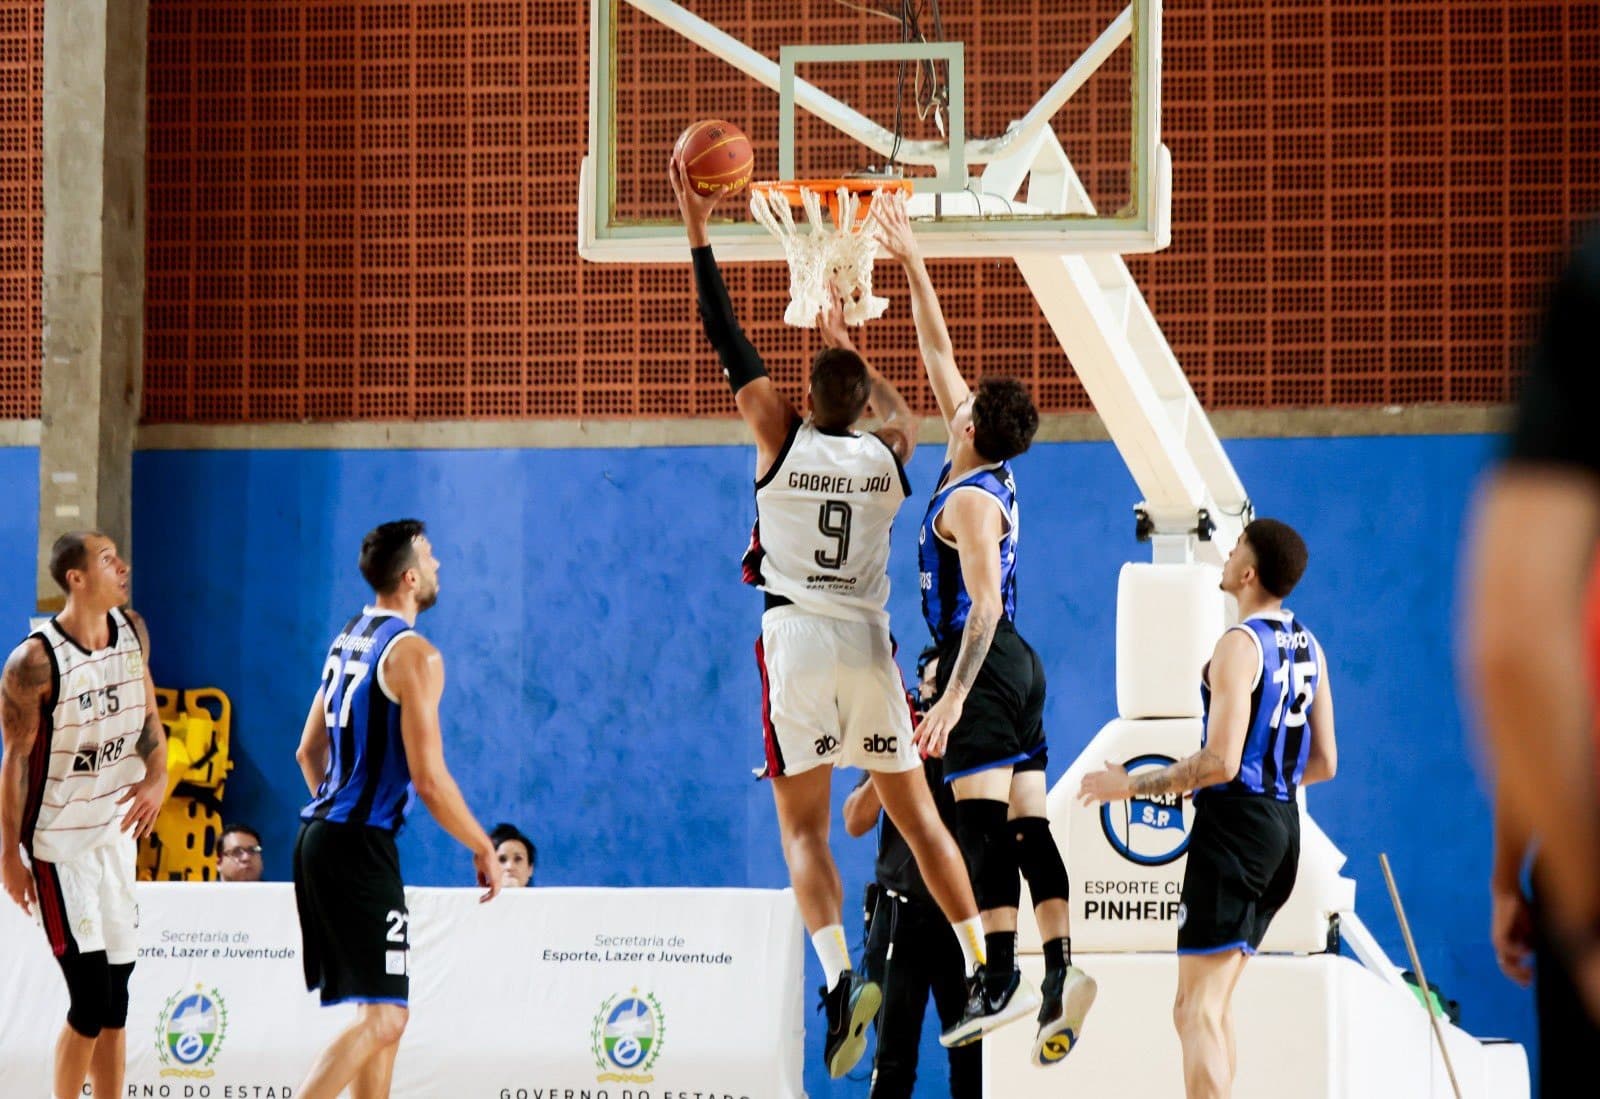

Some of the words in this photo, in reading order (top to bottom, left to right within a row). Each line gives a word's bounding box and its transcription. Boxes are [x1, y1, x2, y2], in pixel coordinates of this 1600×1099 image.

[789, 472, 854, 494] GABRIEL
[860, 472, 891, 493] JAÚ
[815, 500, 852, 569] 9
[322, 655, 370, 728] 27
[1269, 659, 1317, 728] 15
[814, 733, 840, 756] ab
[863, 734, 897, 753] abc
[97, 737, 125, 771] RB
[1085, 881, 1159, 894] ESPORTE
[1165, 881, 1182, 895] CL
[1085, 901, 1180, 920] PINHEIR
[386, 909, 408, 942] 2
[160, 930, 229, 943] Secretaria
[232, 931, 249, 943] de
[594, 934, 664, 947] Secretaria
[667, 935, 685, 948] de
[137, 947, 168, 959] orte,
[171, 946, 209, 958] Lazer
[212, 949, 220, 958] e
[223, 946, 295, 959] Juventude
[542, 949, 601, 963] Esporte,
[605, 950, 644, 962] Lazer
[647, 953, 656, 962] e
[658, 951, 733, 965] Juventude
[184, 1085, 210, 1098] DO
[225, 1086, 292, 1099] ESTAD
[500, 1088, 608, 1099] GOVERNO
